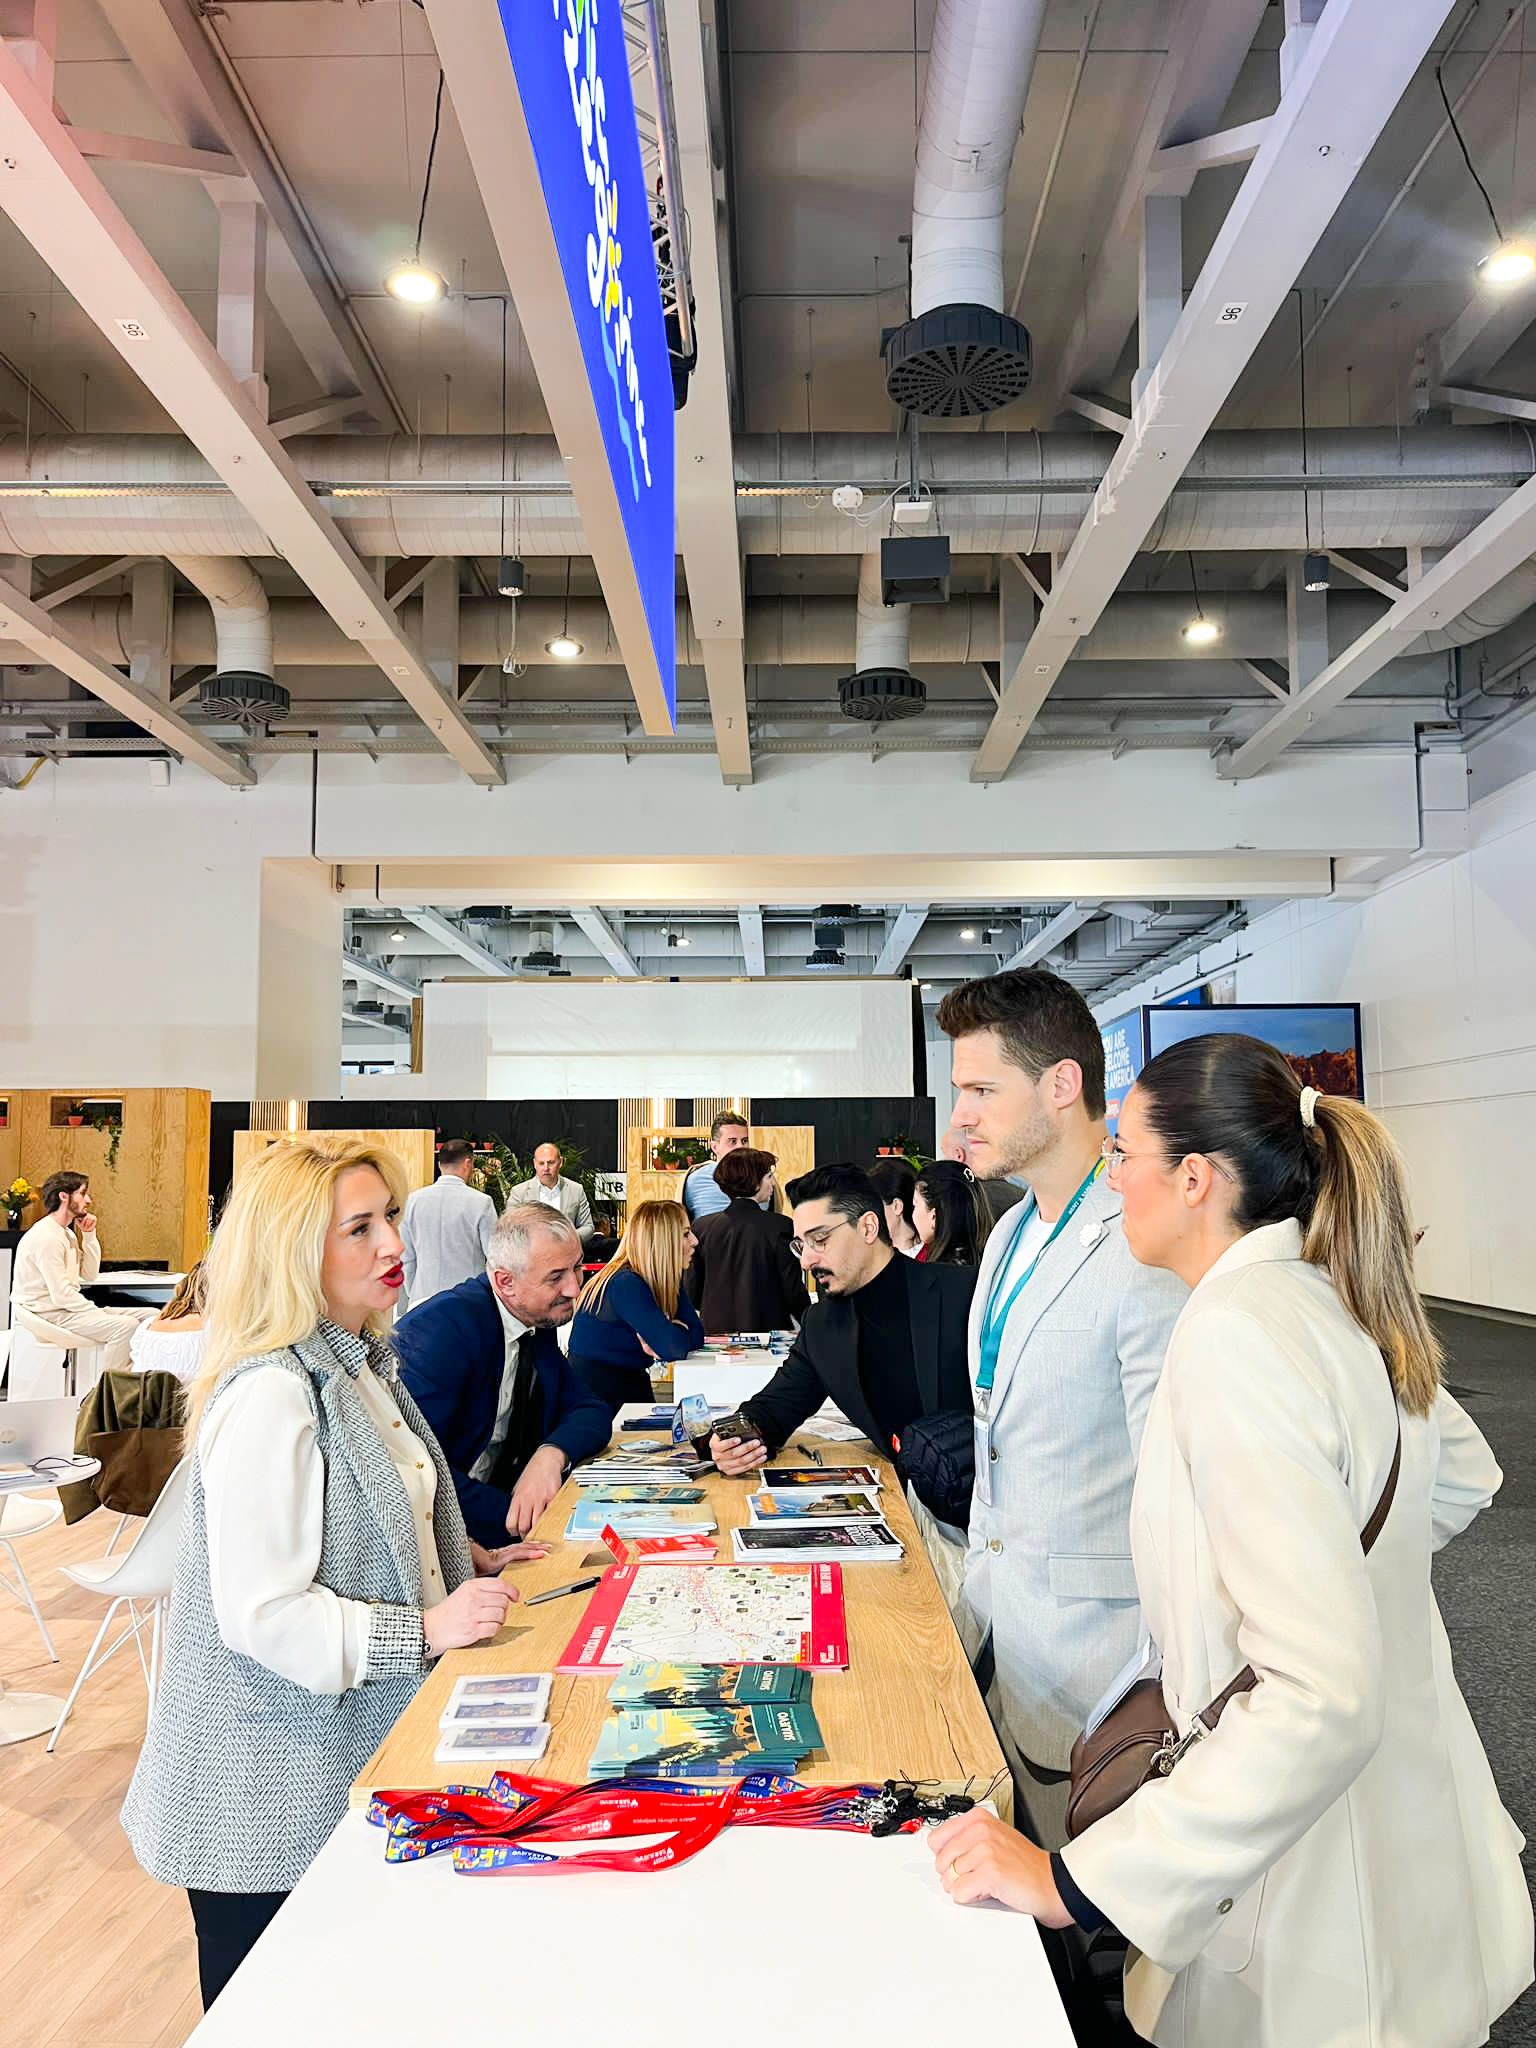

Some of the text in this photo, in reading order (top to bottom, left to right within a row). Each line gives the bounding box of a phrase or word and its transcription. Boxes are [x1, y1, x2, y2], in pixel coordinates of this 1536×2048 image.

[1222, 308, 1242, 320] 96
[1114, 1028, 1126, 1050] ARE
[1109, 1064, 1135, 1090] AMERICA
[776, 1711, 796, 1742] SARAJEVO
